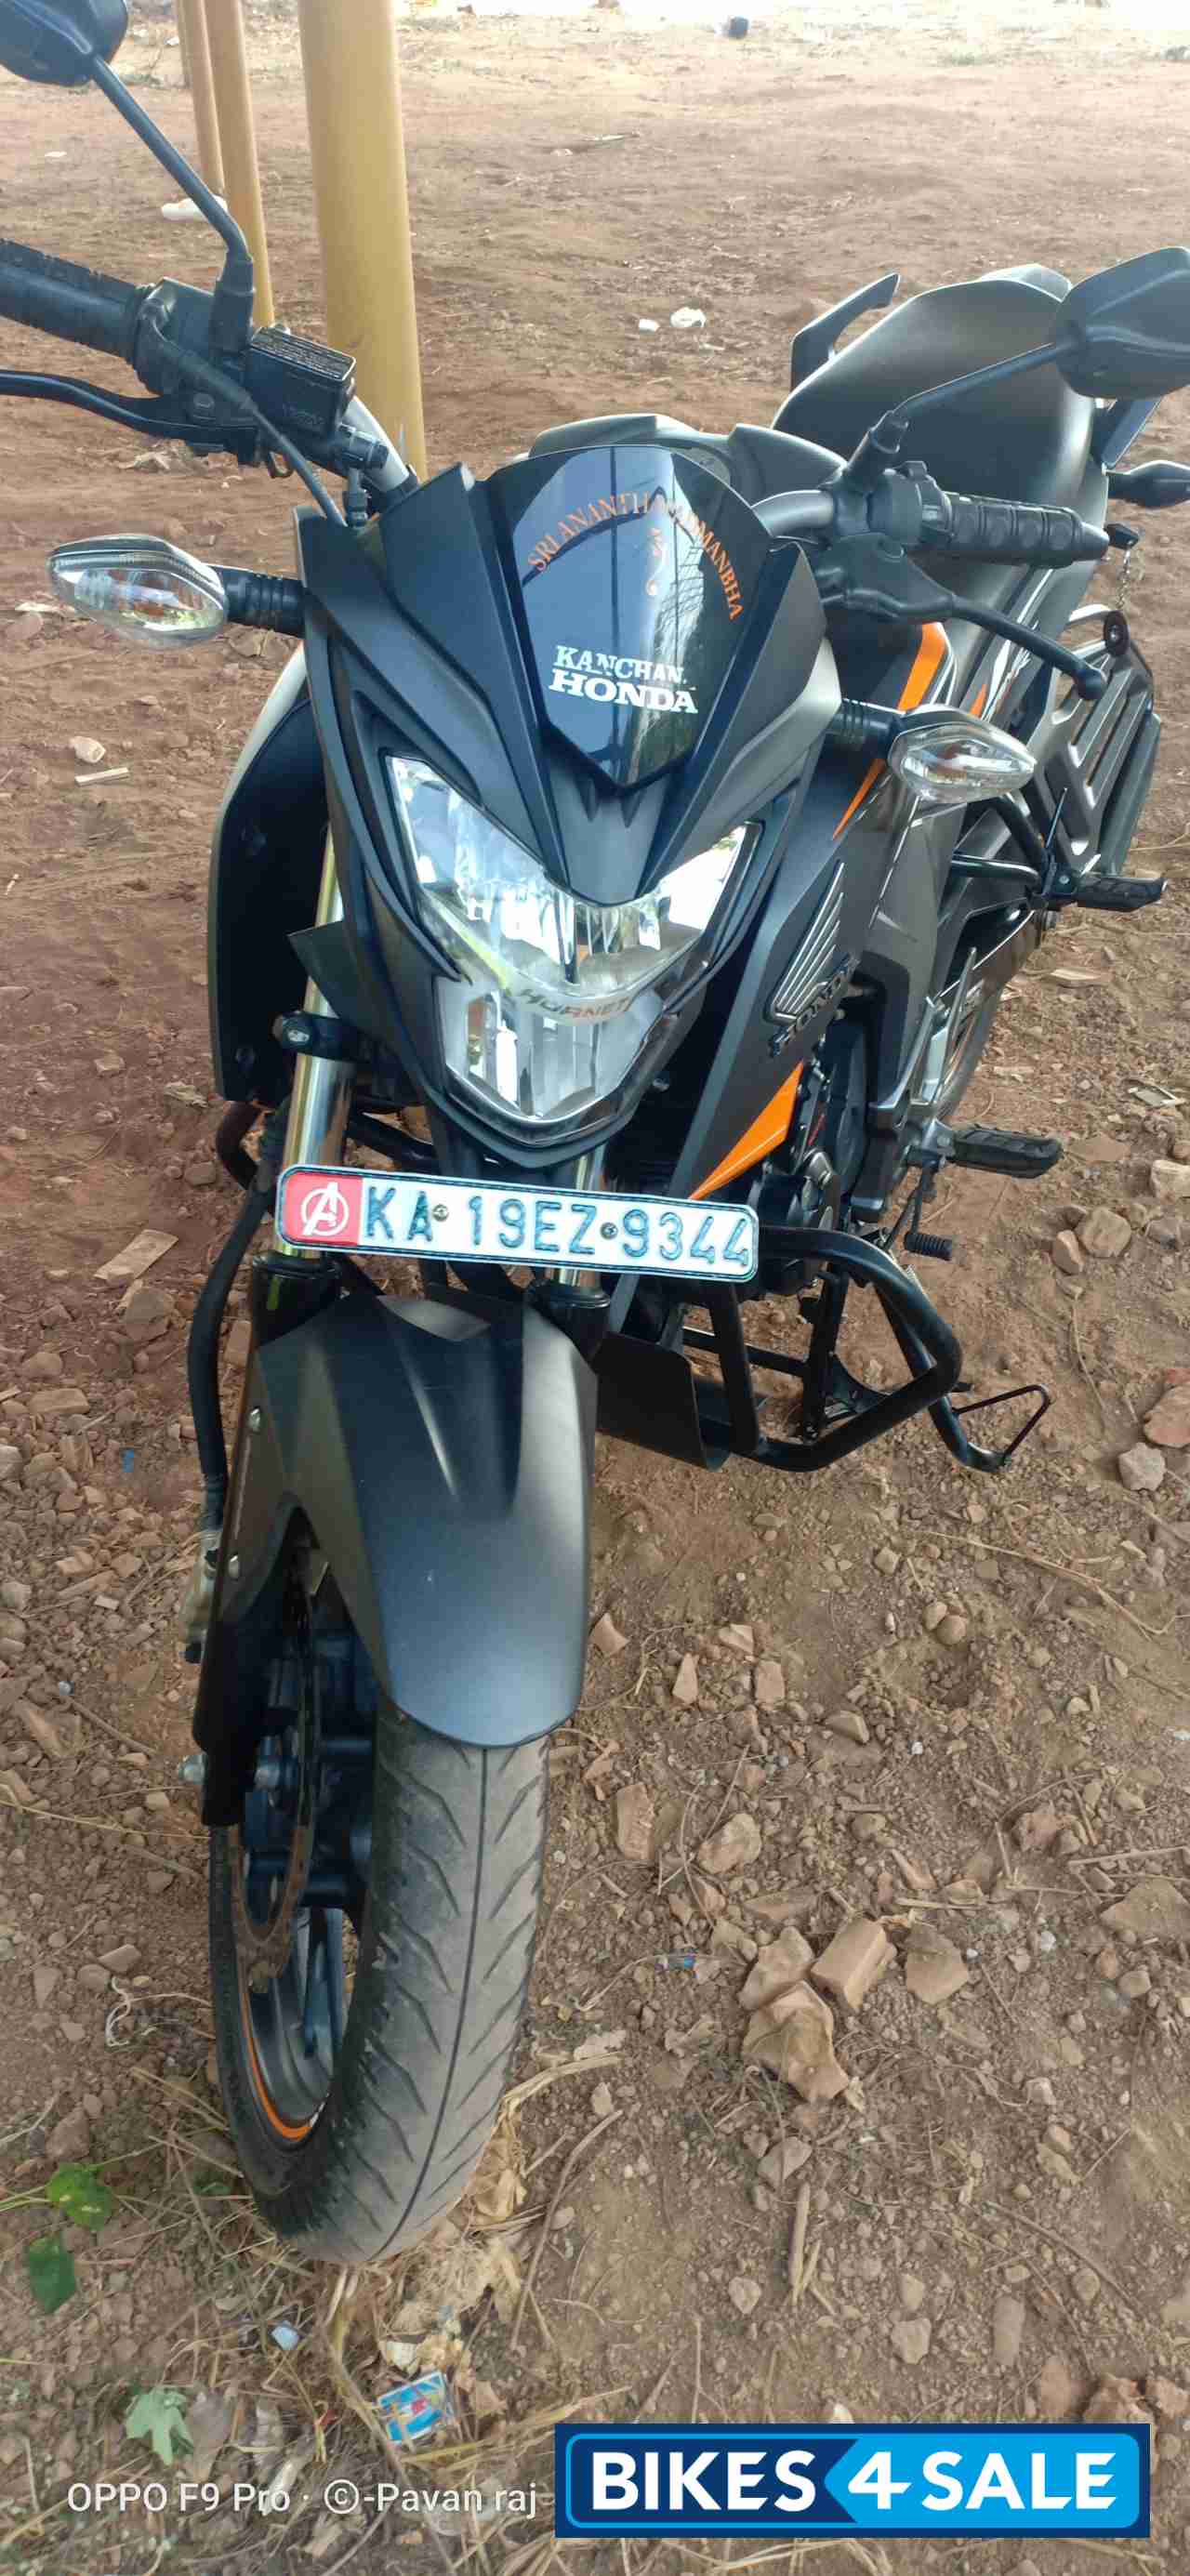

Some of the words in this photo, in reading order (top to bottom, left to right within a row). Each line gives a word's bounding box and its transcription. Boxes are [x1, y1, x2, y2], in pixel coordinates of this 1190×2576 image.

[527, 534, 561, 572] SRI
[548, 667, 699, 714] HONDA
[365, 1185, 434, 1242] KA
[468, 1195, 597, 1256] 19EZ
[621, 1209, 751, 1268] 9344
